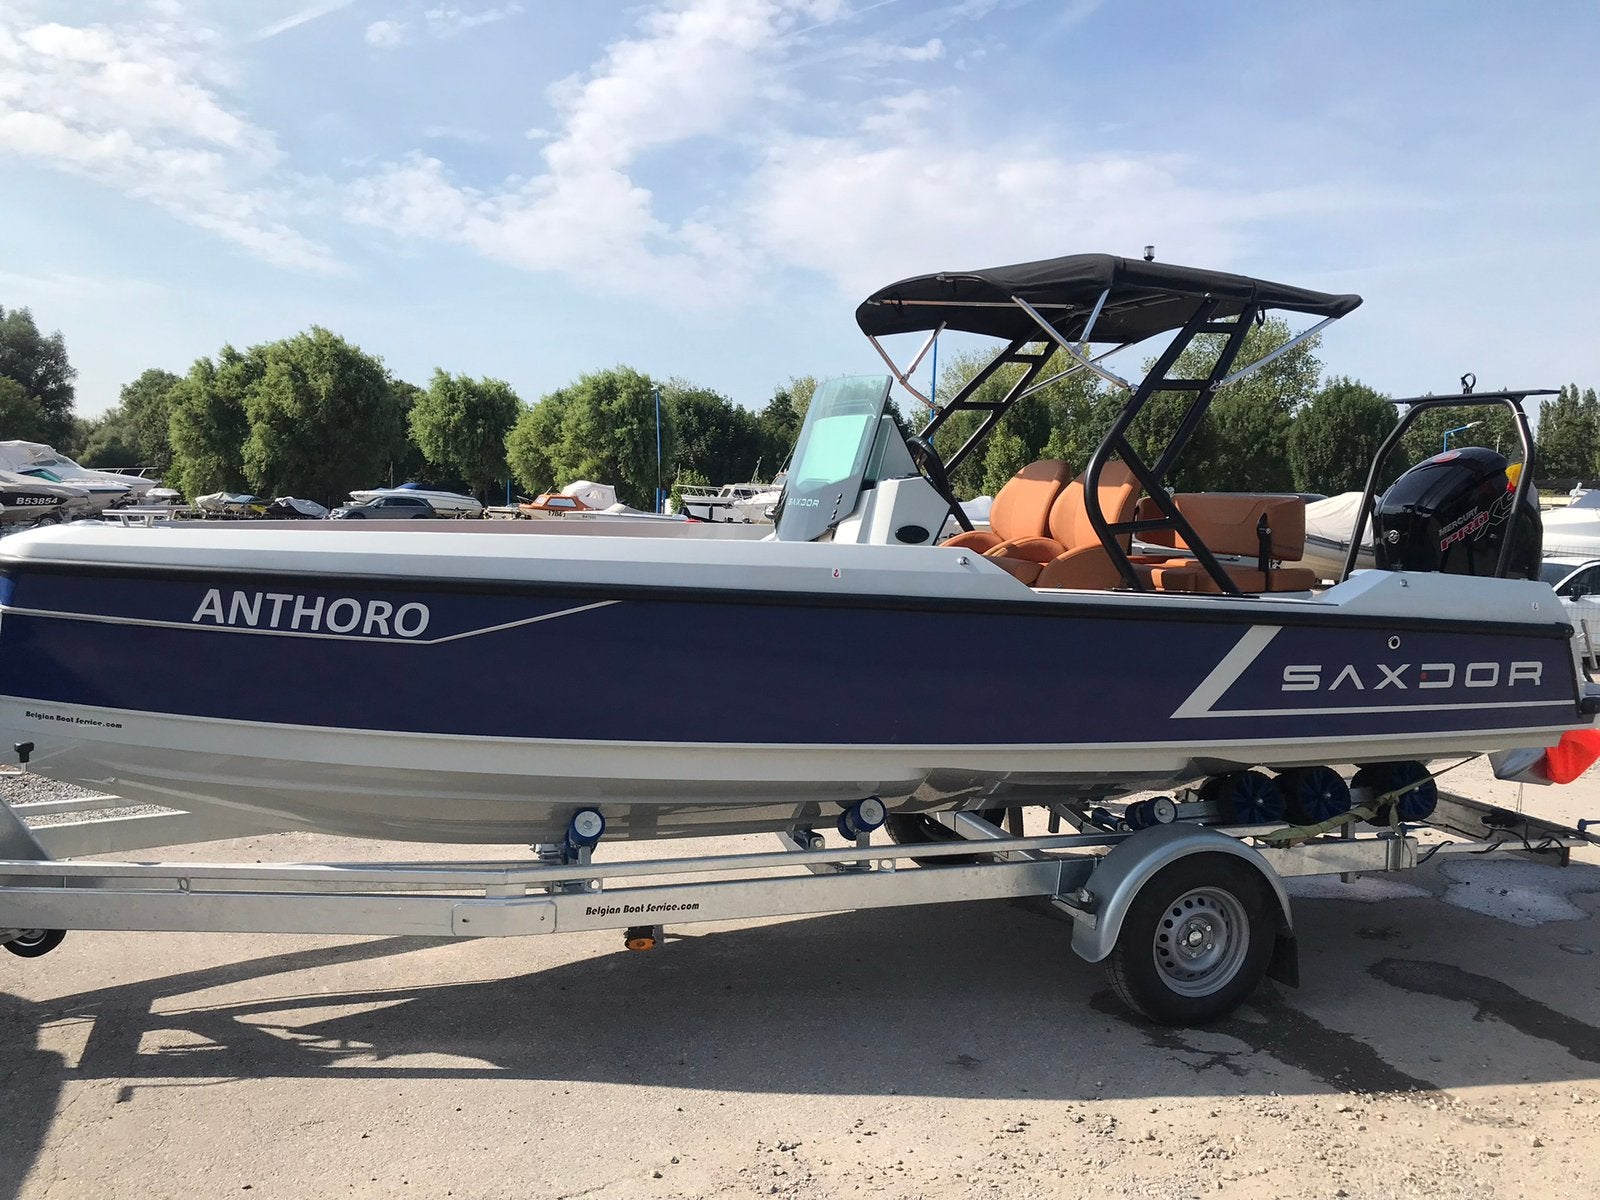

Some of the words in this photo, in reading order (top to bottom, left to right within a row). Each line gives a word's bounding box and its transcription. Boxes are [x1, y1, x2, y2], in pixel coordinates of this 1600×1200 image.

[16, 497, 58, 505] B53854
[787, 497, 820, 507] SAXDOR
[1438, 506, 1480, 537] MERCURY
[192, 588, 430, 637] ANTHORO
[1281, 660, 1544, 692] SAXDOR
[25, 711, 55, 720] Belgian
[56, 715, 74, 724] Boat
[75, 718, 122, 728] Service.com
[586, 906, 620, 916] Belgian
[623, 904, 645, 914] Boat
[646, 902, 699, 912] Service.com
